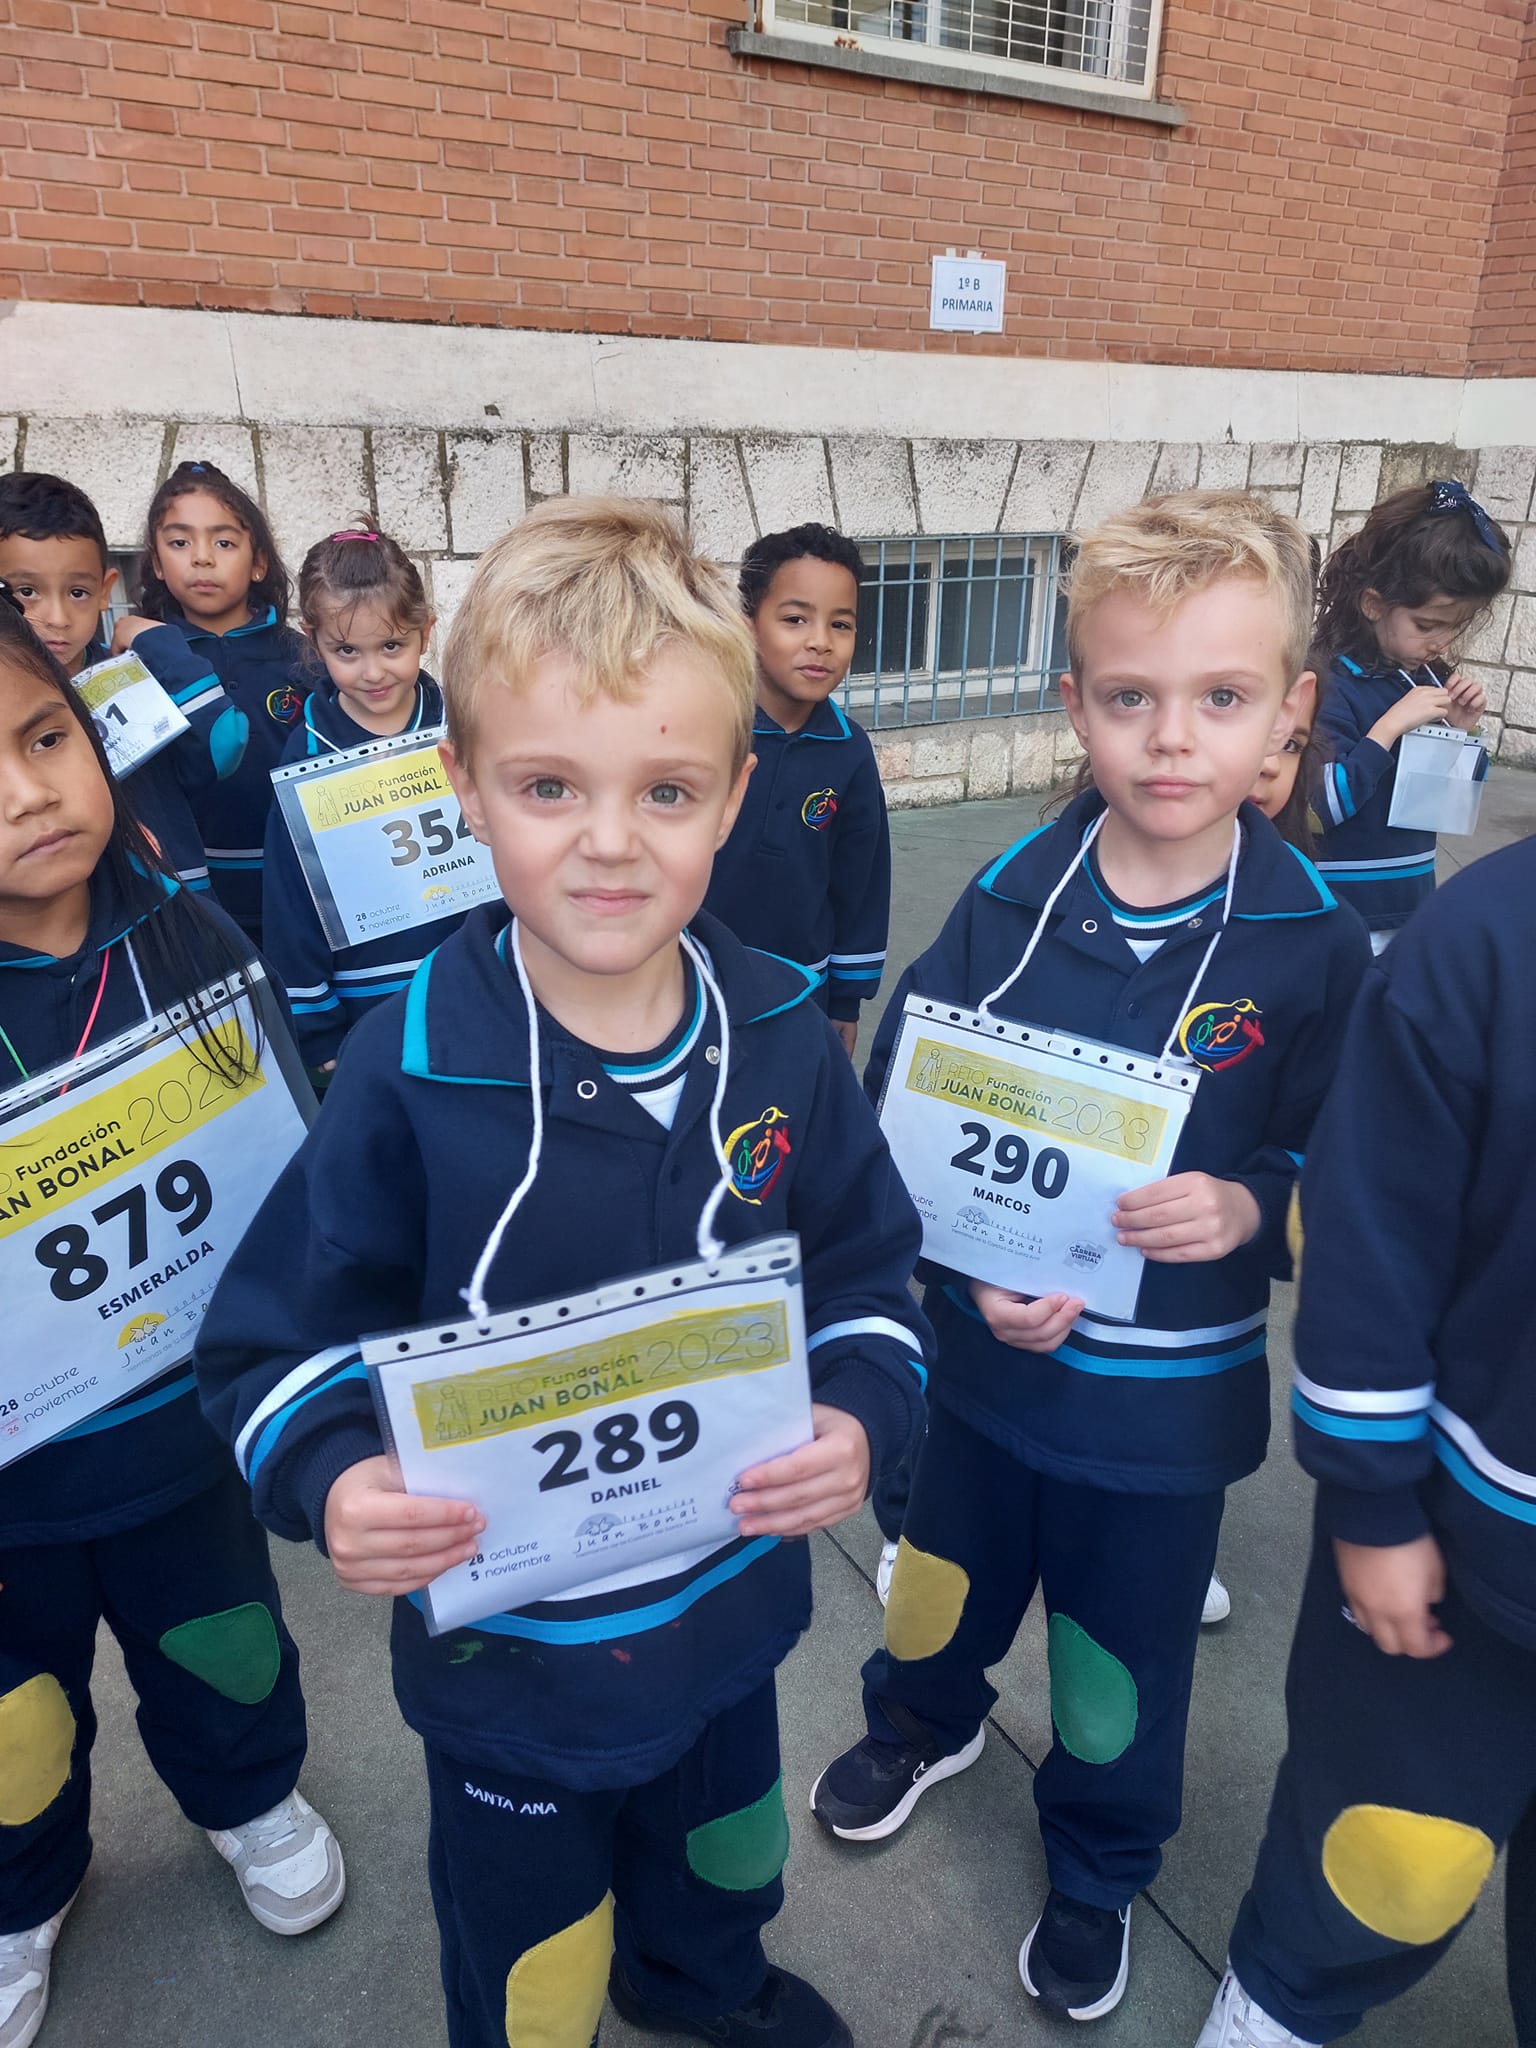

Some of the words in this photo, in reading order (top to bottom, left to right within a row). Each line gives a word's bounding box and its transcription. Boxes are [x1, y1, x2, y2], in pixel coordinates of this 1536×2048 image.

[958, 277, 970, 290] 1º
[973, 278, 981, 291] B
[942, 298, 993, 312] PRIMARIA
[343, 793, 385, 816] JUAN
[389, 778, 442, 802] BONAL
[377, 766, 437, 789] Fundación
[422, 855, 475, 880] ADRIANA
[355, 912, 367, 921] 28
[359, 924, 366, 933] 5
[941, 1078, 984, 1103] JUAN
[987, 1092, 1047, 1123] BONAL
[947, 1062, 985, 1085] RETO
[986, 1077, 1052, 1105] Fundación
[1051, 1096, 1150, 1151] 2023
[15, 1119, 121, 1181] Fundación
[949, 1121, 1070, 1199] 290
[0, 1190, 32, 1221] AN
[36, 1138, 135, 1200] BONAL
[972, 1186, 1031, 1215] MARCOS
[34, 1158, 213, 1302] 879
[951, 1219, 988, 1236] Juan
[998, 1233, 1042, 1254] Bonal
[96, 1239, 215, 1321] ESMERALDA
[121, 1328, 174, 1369] Juan
[647, 1321, 776, 1380] 2023
[0, 1398, 19, 1417] 28
[23, 1366, 80, 1402] octubre
[542, 1353, 639, 1389] Fundación
[23, 1376, 99, 1424] noviembre
[479, 1395, 545, 1427] JUAN
[556, 1371, 643, 1407] BONAL
[531, 1400, 701, 1492] 289
[591, 1478, 662, 1504] DANIEL
[574, 1530, 625, 1554] Juan
[637, 1506, 698, 1532] Bonal
[470, 1570, 479, 1581] 5
[484, 1553, 551, 1578] noviembre
[489, 1541, 539, 1561] octubre
[464, 1781, 515, 1812] SANTA
[519, 1802, 558, 1815] ANA
